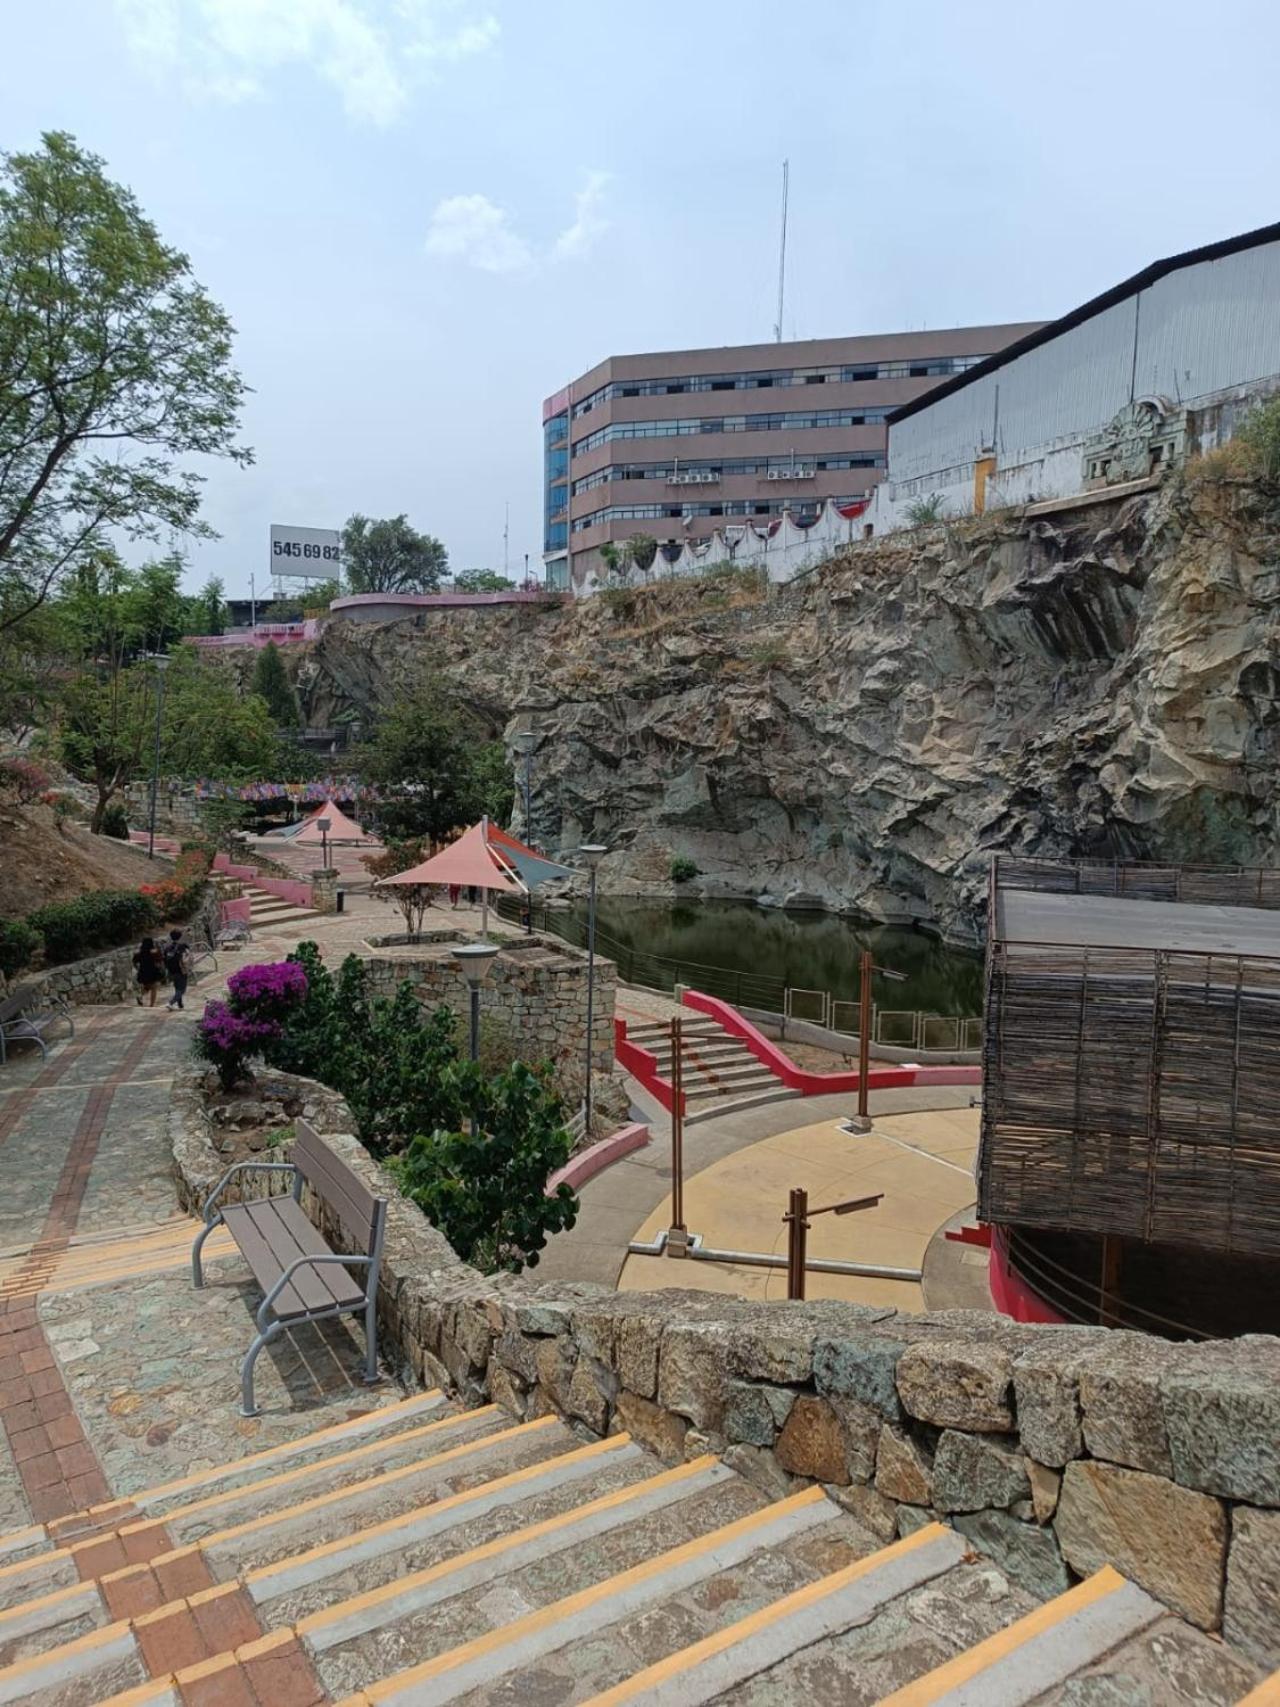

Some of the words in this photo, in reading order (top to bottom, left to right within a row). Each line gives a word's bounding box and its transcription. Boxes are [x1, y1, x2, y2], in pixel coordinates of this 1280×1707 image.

[273, 541, 301, 557] 545
[304, 544, 320, 558] 69
[323, 545, 340, 560] 82
